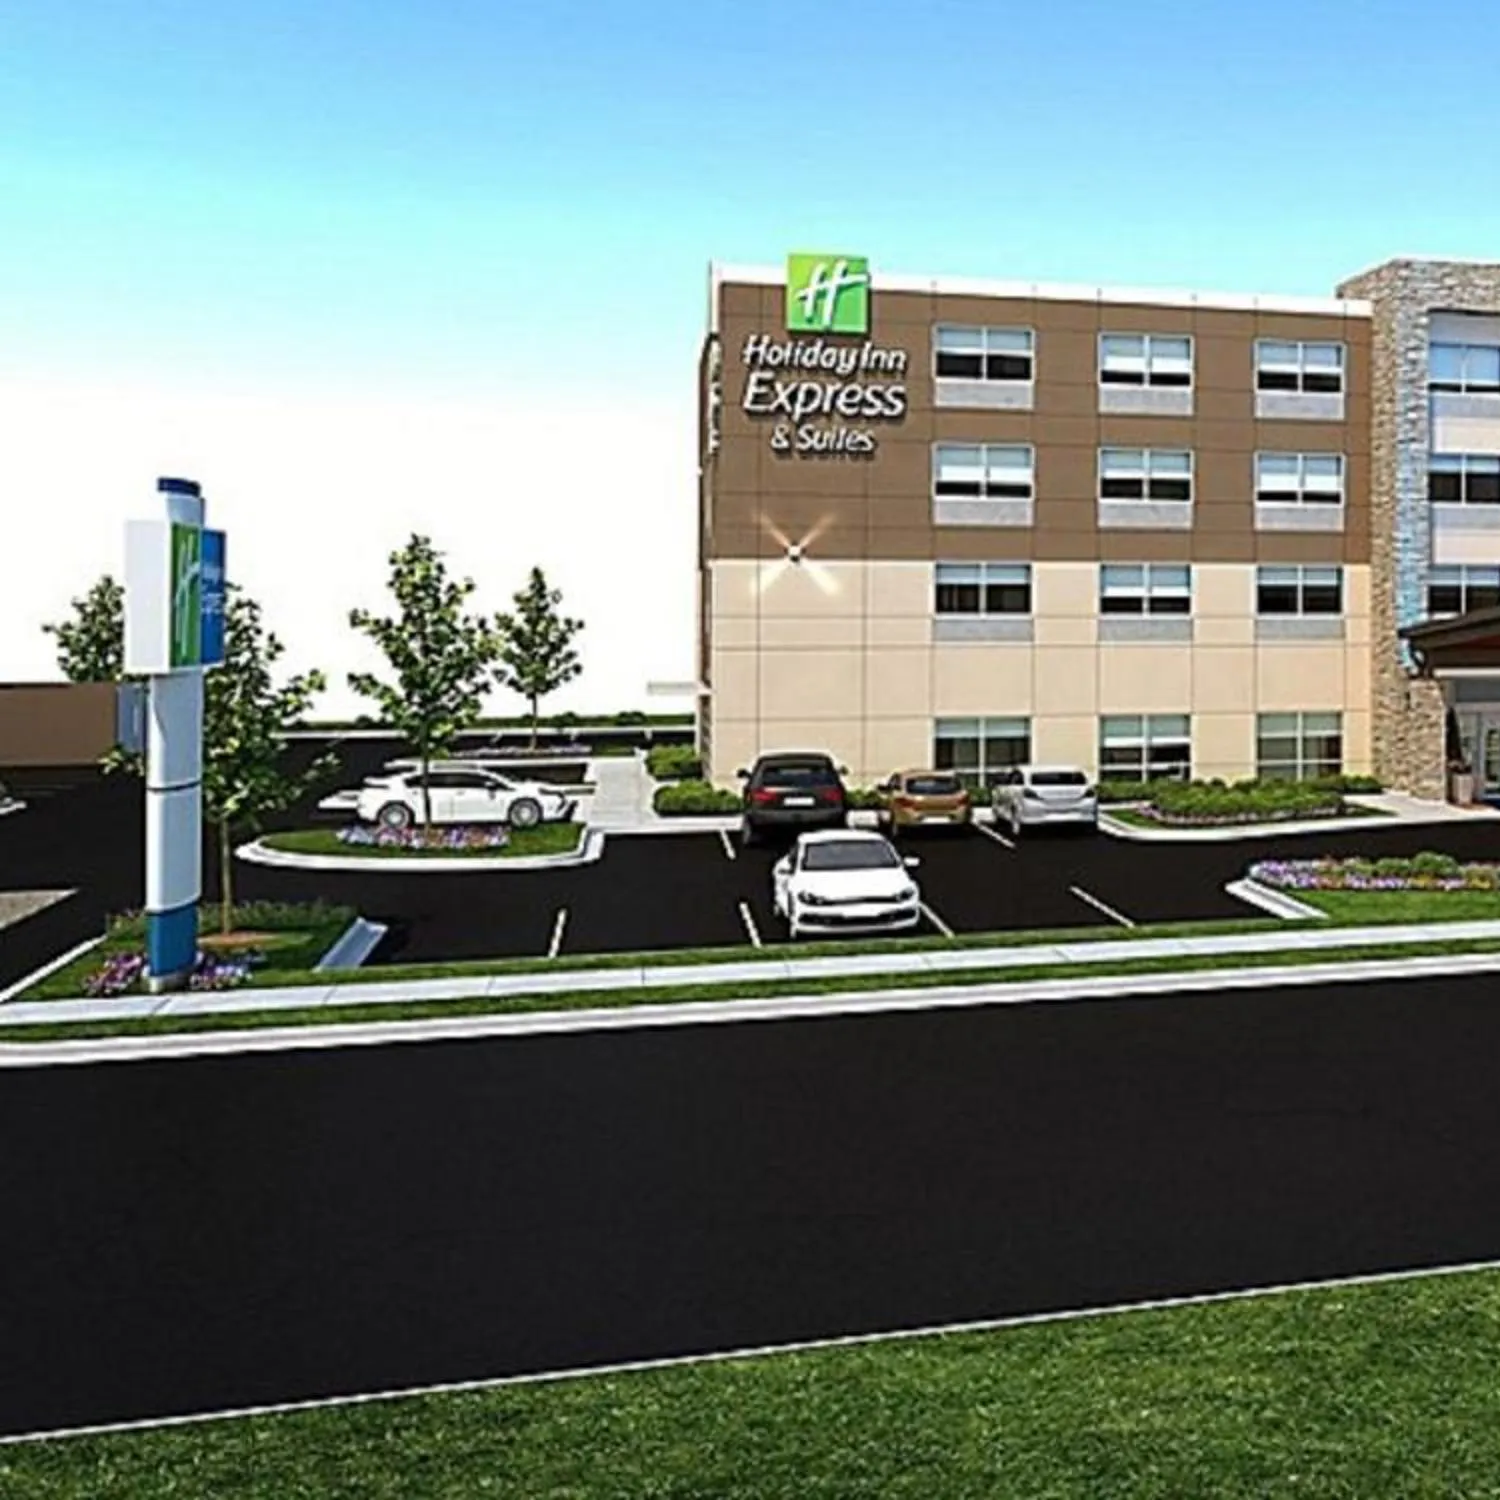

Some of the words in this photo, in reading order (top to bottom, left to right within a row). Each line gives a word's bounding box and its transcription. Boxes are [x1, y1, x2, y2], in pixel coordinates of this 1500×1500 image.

[743, 335, 854, 375] Holiday
[860, 341, 907, 371] Inn
[743, 371, 907, 422] Express
[770, 423, 790, 449] &
[795, 424, 875, 451] Suites
